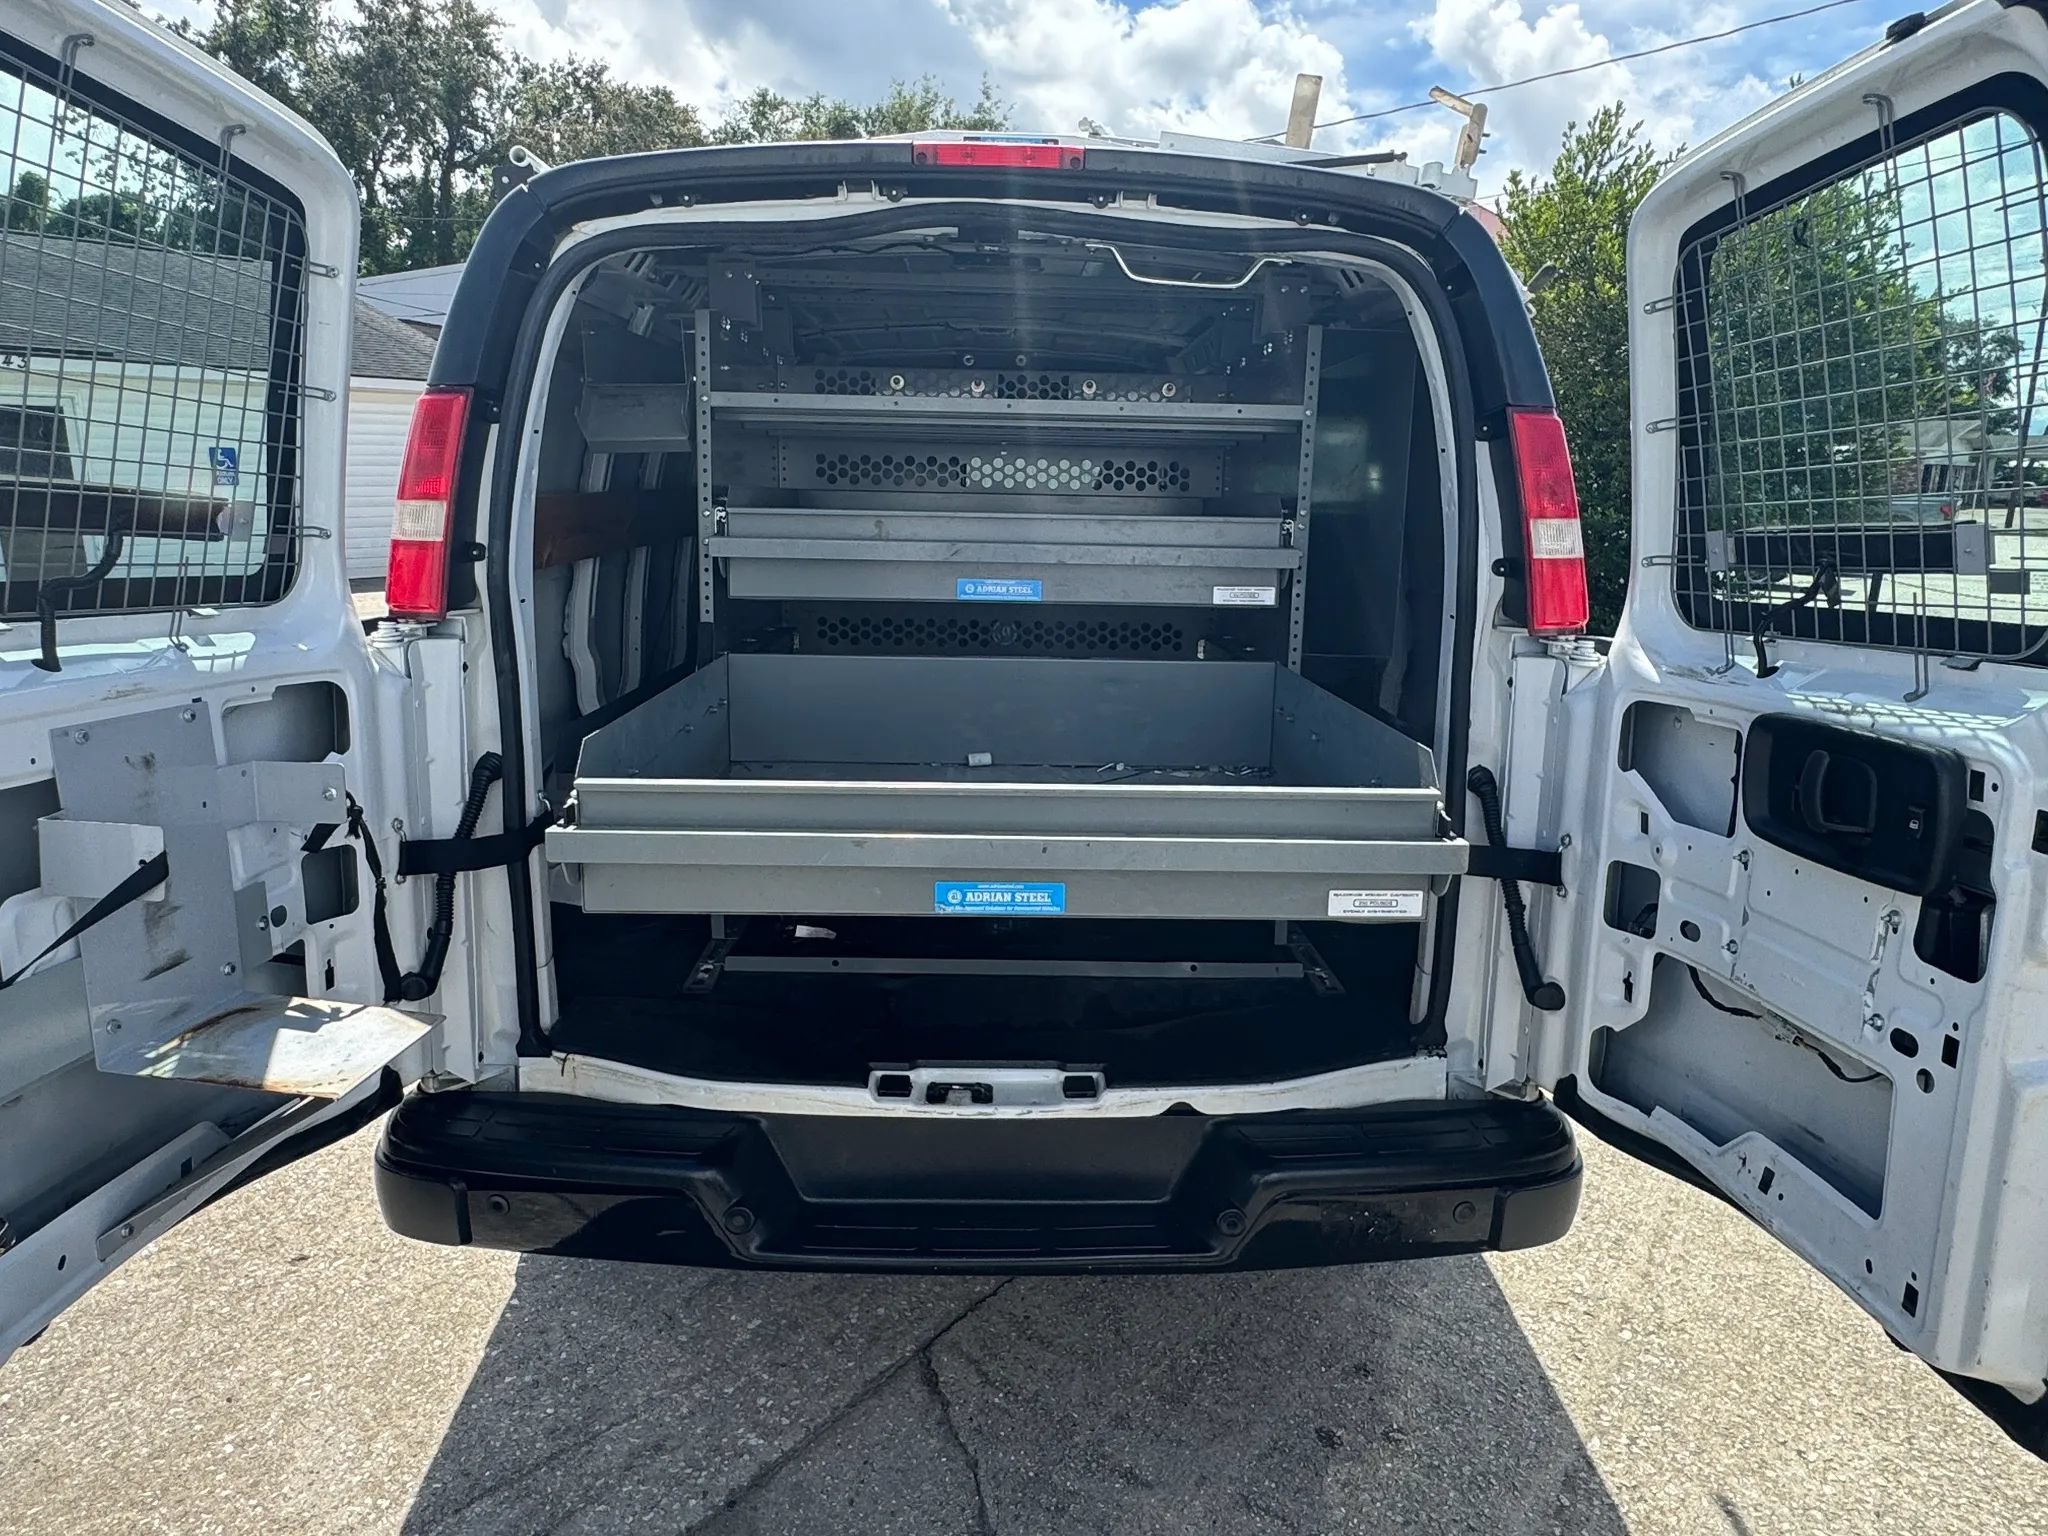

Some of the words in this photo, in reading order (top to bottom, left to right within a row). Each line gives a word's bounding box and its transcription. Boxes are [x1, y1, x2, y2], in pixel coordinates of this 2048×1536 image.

[977, 585, 1007, 593] ADRIAN
[1008, 586, 1033, 594] STEEL
[965, 892, 1011, 903] ADRIAN
[1014, 892, 1052, 903] STEEL
